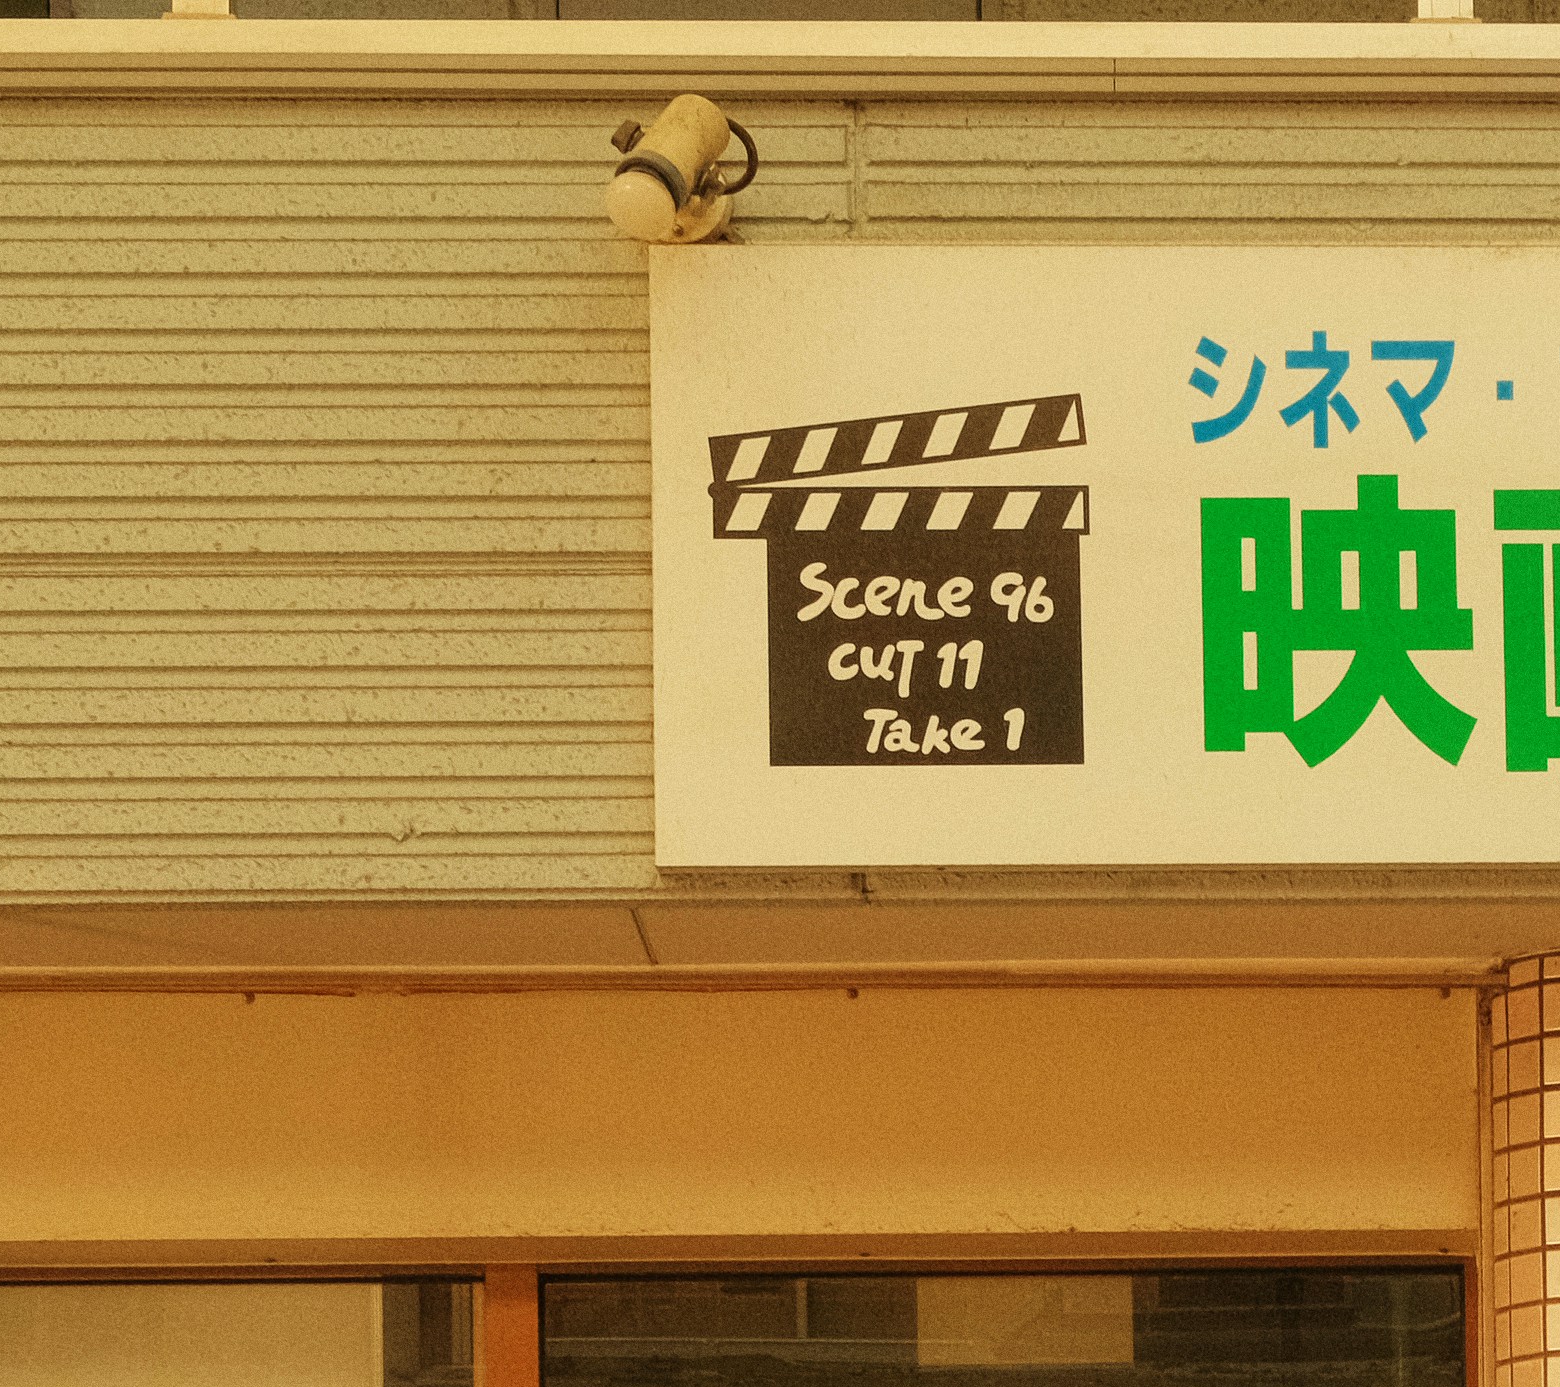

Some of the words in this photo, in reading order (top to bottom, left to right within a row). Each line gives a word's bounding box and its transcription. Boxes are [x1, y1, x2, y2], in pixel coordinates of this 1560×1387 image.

[797, 561, 974, 622] Scene
[990, 571, 1054, 623] 96
[937, 639, 983, 690] 11
[863, 708, 985, 754] Take
[1003, 707, 1025, 751] 1
